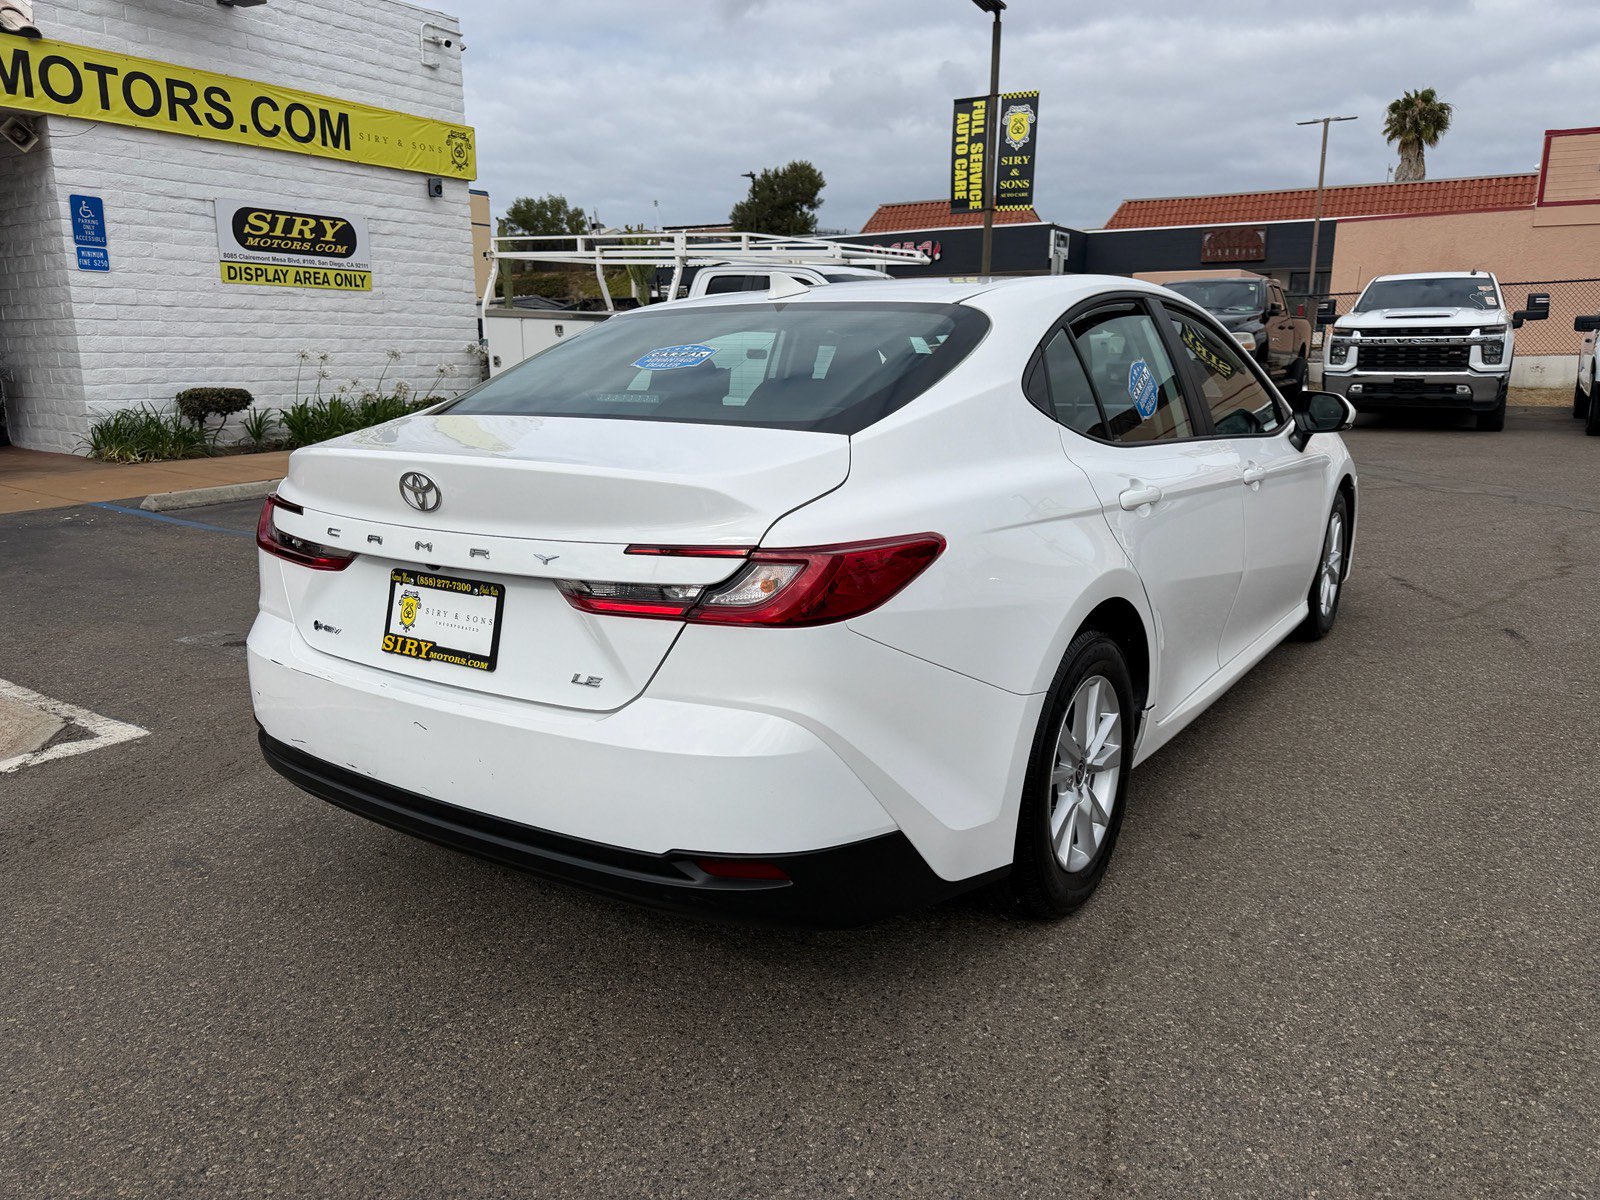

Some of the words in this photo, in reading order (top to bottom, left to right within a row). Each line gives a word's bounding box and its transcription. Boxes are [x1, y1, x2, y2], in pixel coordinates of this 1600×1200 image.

[0, 48, 351, 151] MOTORS.COM
[972, 100, 986, 136] FULL
[359, 132, 388, 145] SIRY
[397, 139, 403, 147] &
[412, 142, 443, 154] SONS
[955, 113, 969, 155] AUTO
[1001, 155, 1030, 166] SIRY
[954, 158, 968, 200] CARE
[969, 142, 984, 210] SERVICE
[1010, 168, 1020, 176] &
[1000, 179, 1030, 189] SONS
[243, 211, 347, 242] SIRY
[76, 235, 105, 243] ACCESSIBLE
[245, 237, 348, 254] MOTORS.COM
[79, 259, 91, 267] FINE
[81, 250, 104, 258] MINIMUM
[223, 252, 238, 260] 8085
[239, 253, 270, 262] Clairemont
[227, 265, 289, 284] DISPLAY
[294, 270, 331, 286] AREA
[334, 272, 367, 288] ONLY
[327, 527, 560, 565] CAMRY
[416, 575, 436, 587] (858)
[436, 579, 471, 592] 277-7300
[425, 607, 448, 618] SIRY
[465, 614, 493, 626] SONS
[382, 635, 433, 659] SIRY
[429, 651, 489, 670] MOTORS.COM
[571, 673, 603, 689] LE
